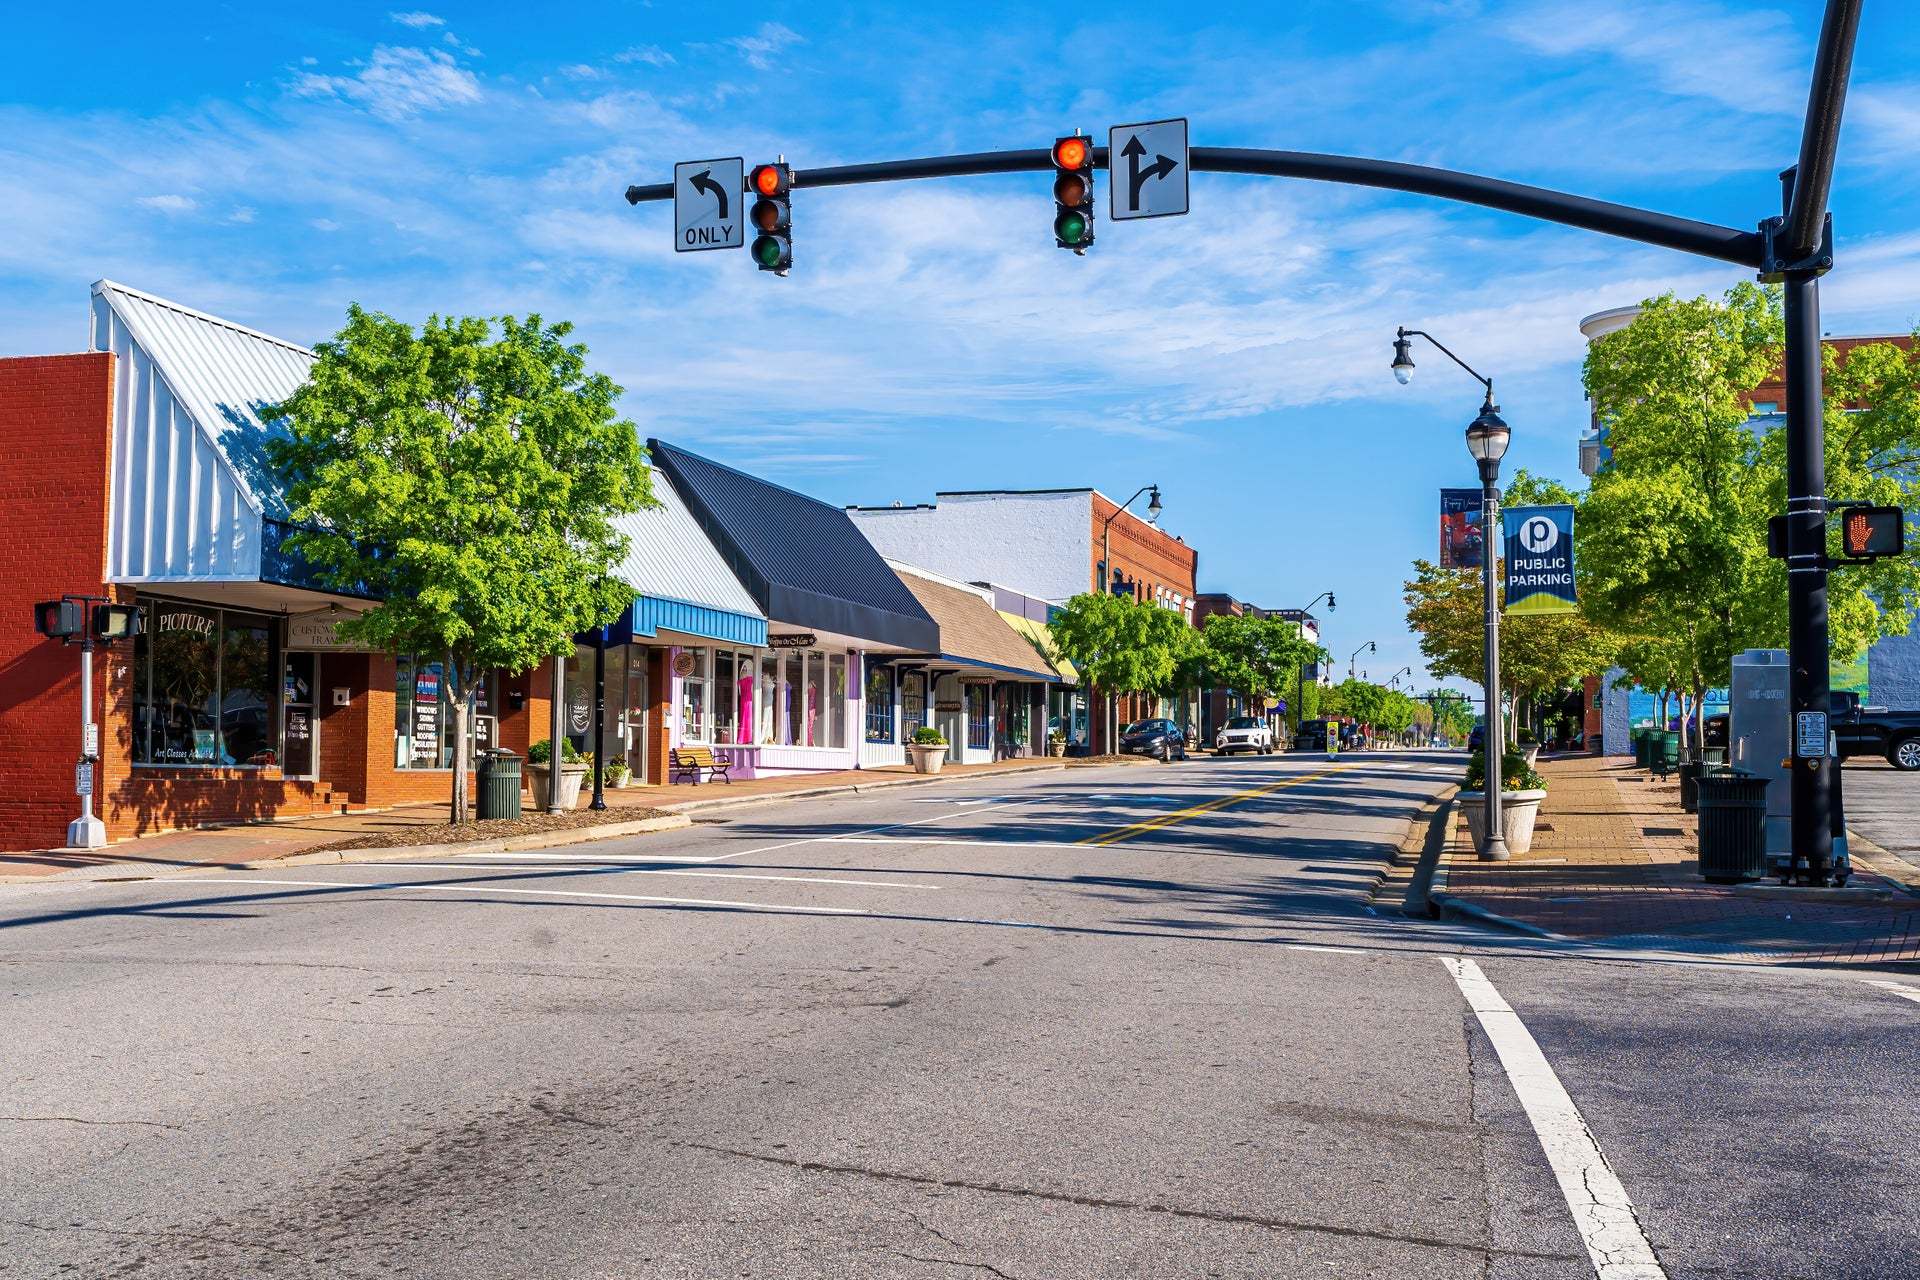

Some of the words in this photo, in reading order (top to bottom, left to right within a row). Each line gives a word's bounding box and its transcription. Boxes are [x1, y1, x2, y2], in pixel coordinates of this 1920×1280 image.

[685, 225, 733, 245] ONLY
[1514, 557, 1565, 571] PUBLIC
[1509, 573, 1572, 587] PARKING
[159, 613, 215, 638] PICTURE
[416, 706, 437, 714] WINDOWS
[416, 723, 436, 732] GUTTERS
[154, 747, 165, 758] Art
[166, 747, 187, 758] Classes
